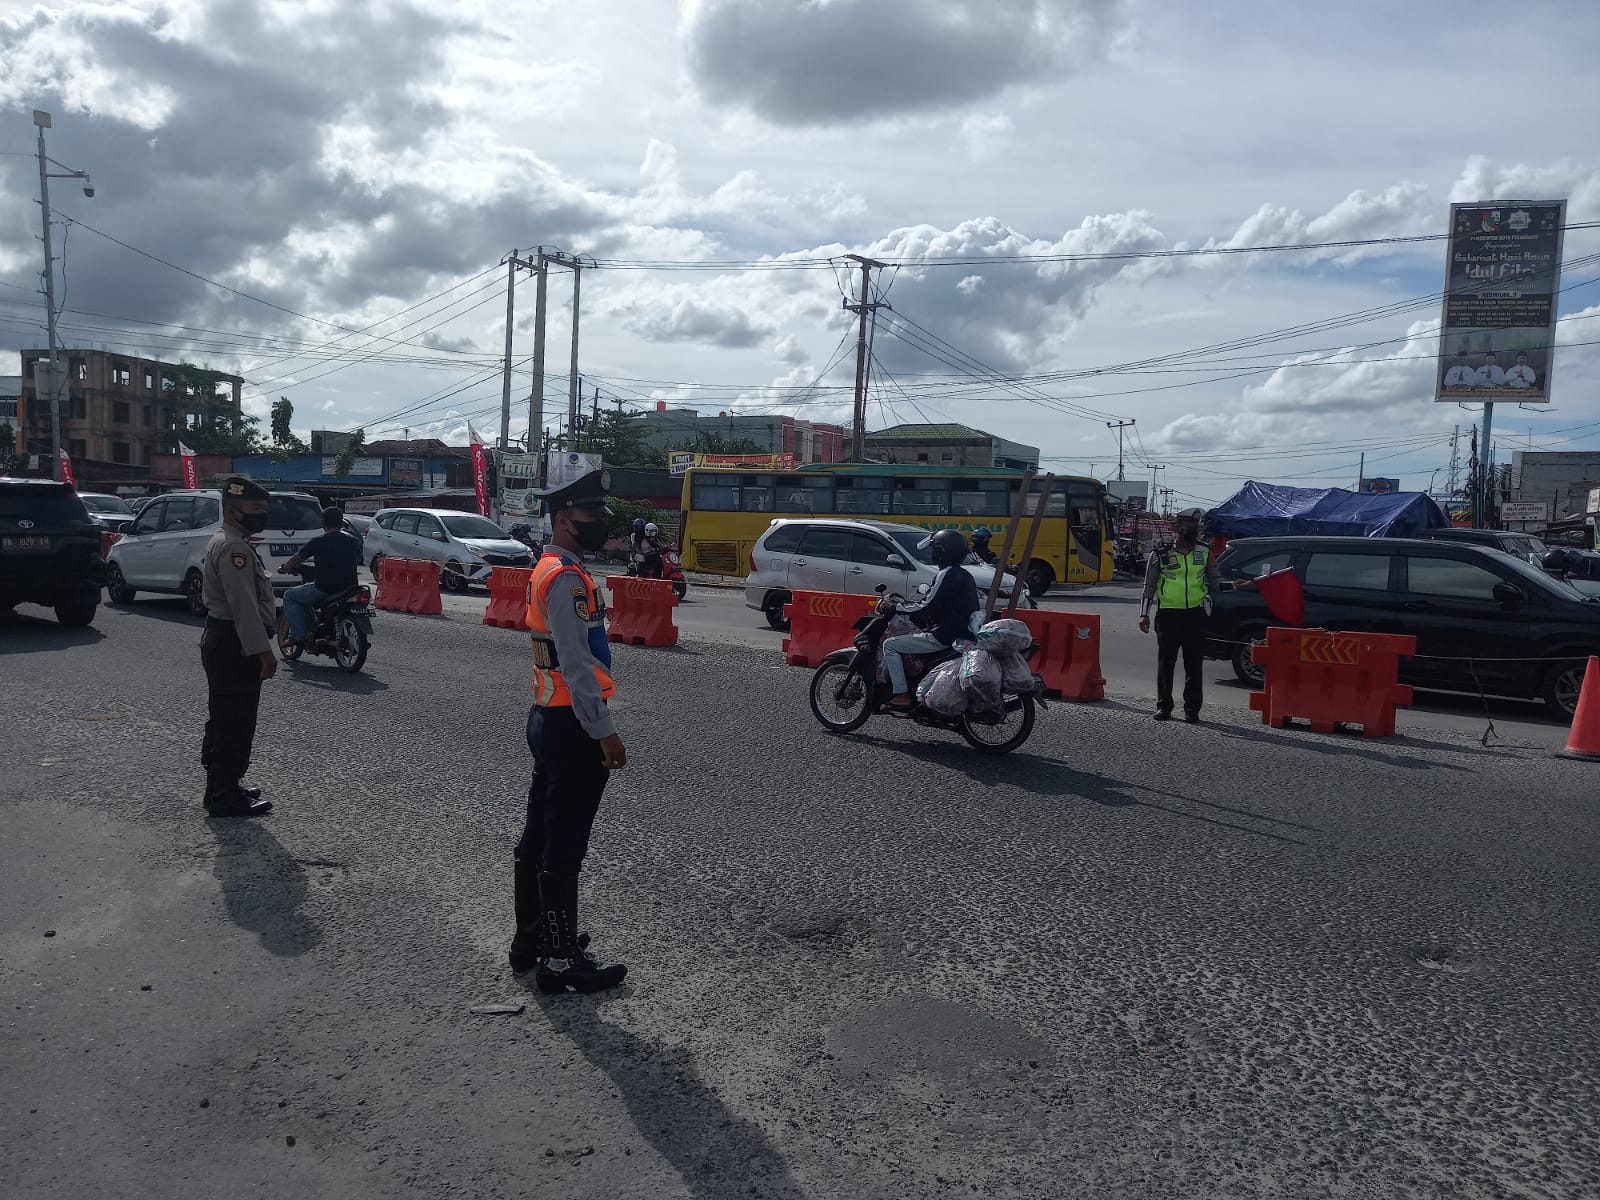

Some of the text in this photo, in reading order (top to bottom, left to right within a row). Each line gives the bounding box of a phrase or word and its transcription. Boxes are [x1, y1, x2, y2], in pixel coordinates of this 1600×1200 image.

[1455, 252, 1497, 262] Selamat
[1500, 252, 1521, 261] Hari
[1465, 263, 1495, 280] Idul
